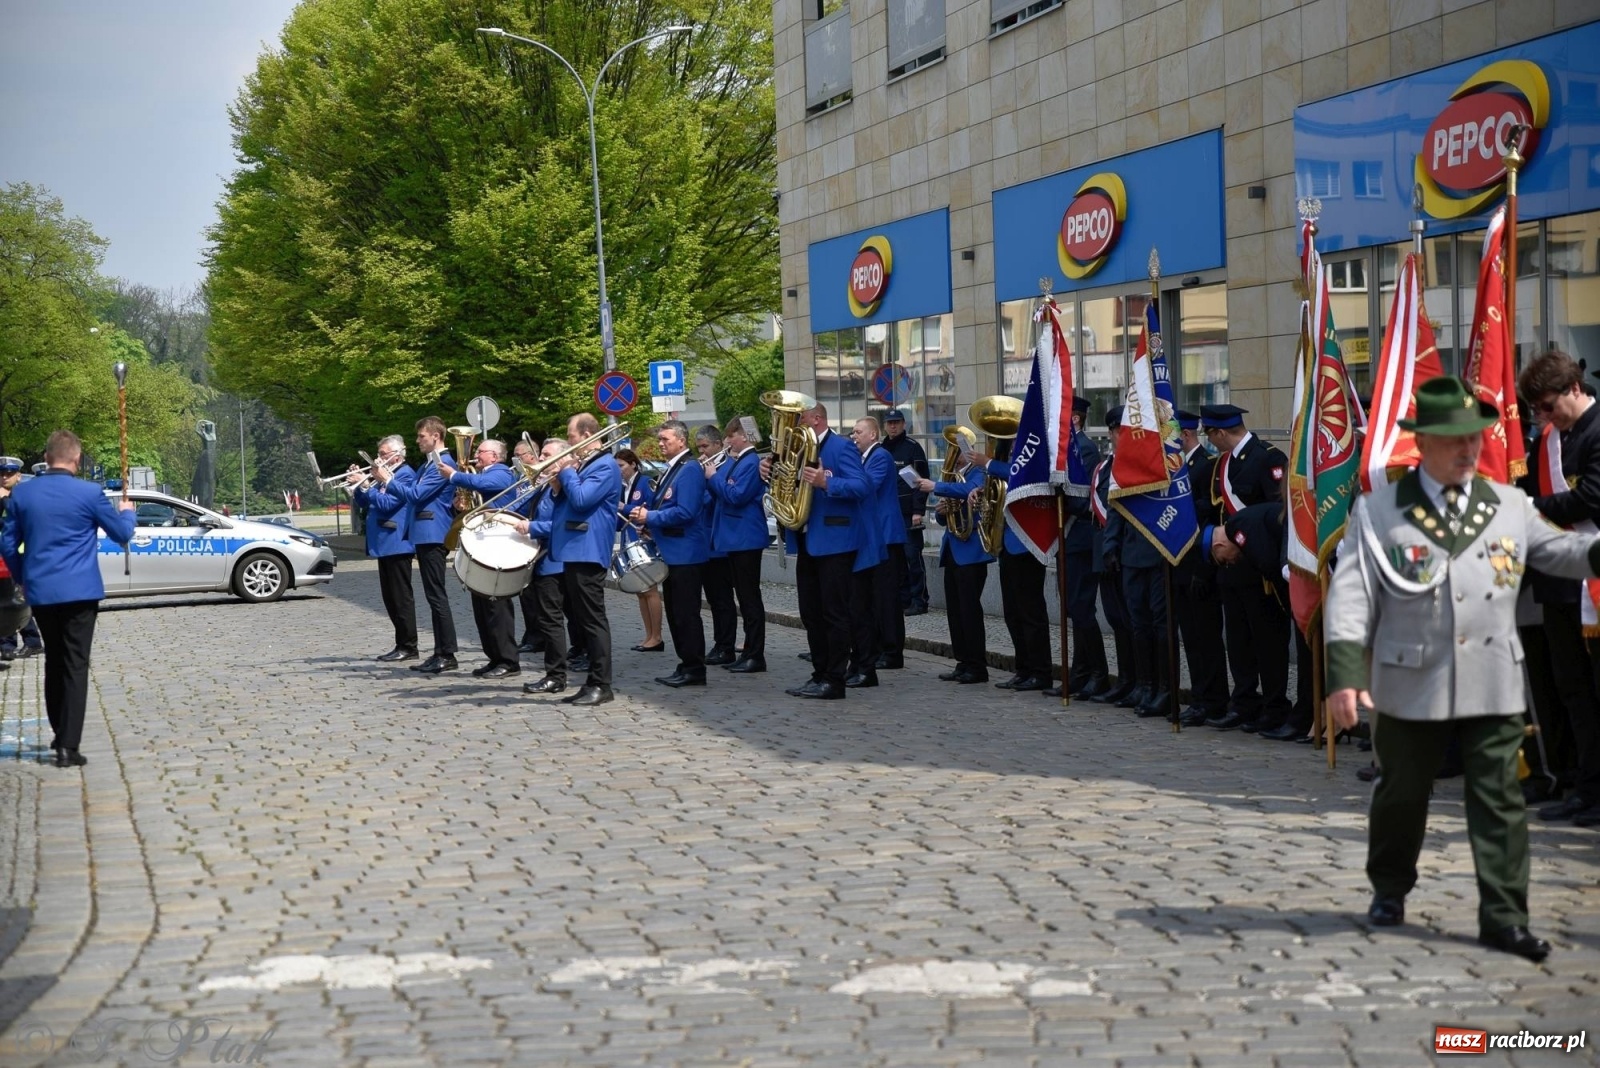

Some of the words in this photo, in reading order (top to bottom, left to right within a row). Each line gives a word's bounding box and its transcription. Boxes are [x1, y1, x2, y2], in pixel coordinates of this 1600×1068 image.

[1432, 111, 1520, 171] PEPCO
[1067, 207, 1109, 245] PEPCO
[853, 262, 880, 291] PEPCO
[657, 365, 677, 392] P
[1156, 504, 1178, 531] 1858
[157, 540, 213, 552] POLICJA
